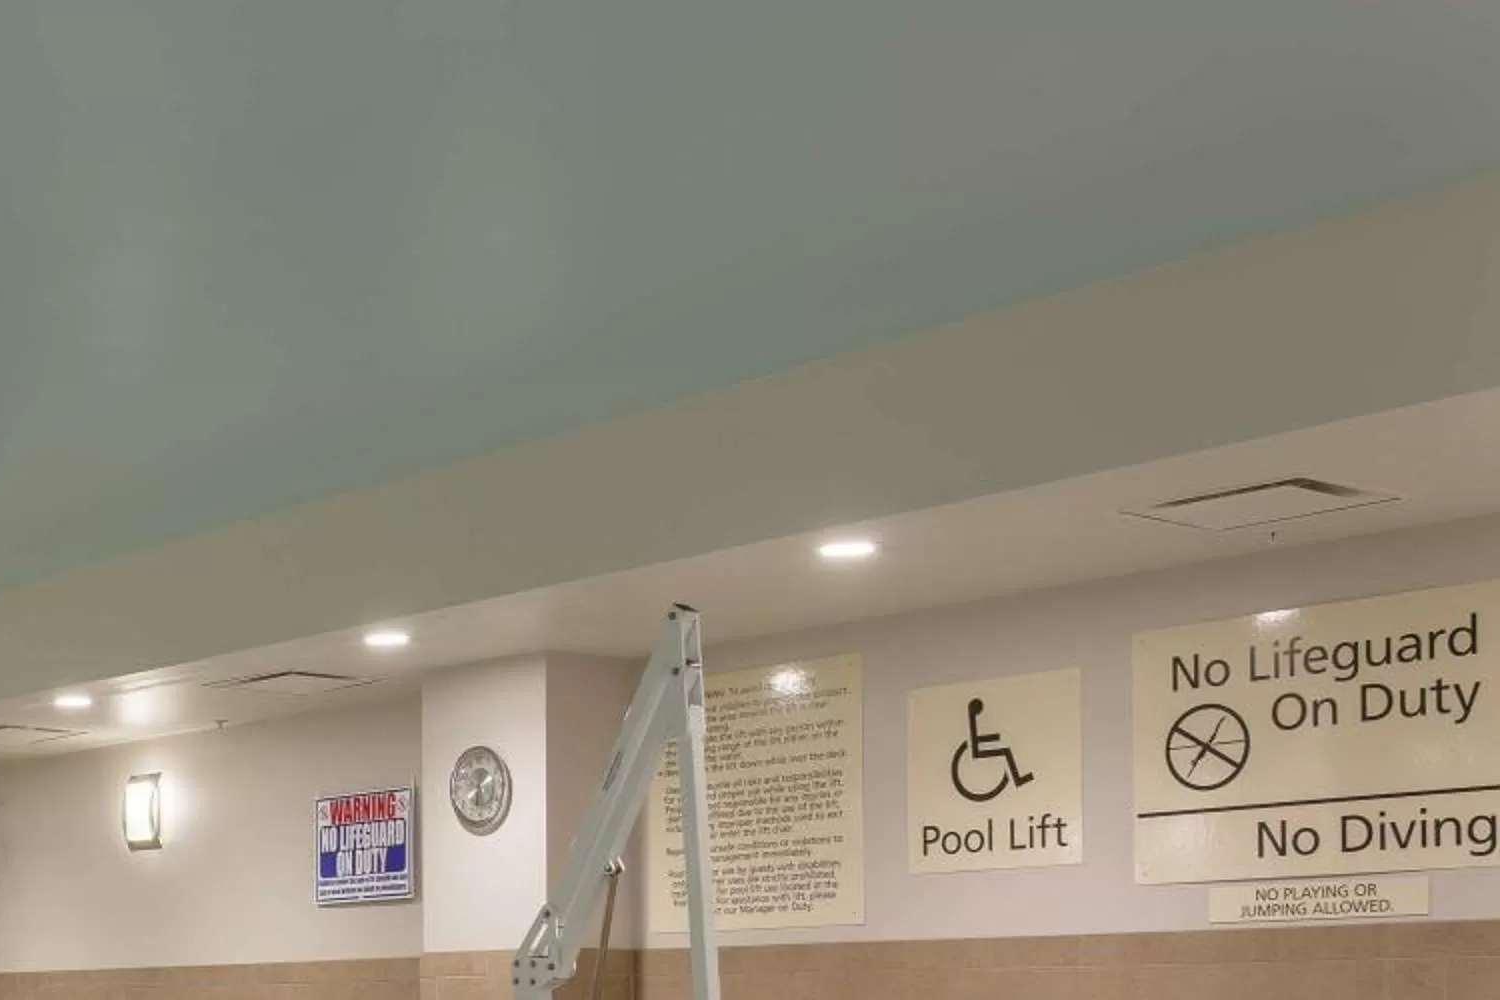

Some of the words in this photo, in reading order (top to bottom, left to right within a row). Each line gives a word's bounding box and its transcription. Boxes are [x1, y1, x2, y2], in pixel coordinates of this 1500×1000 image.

[1172, 653, 1231, 692] No
[1250, 612, 1479, 682] Lifeguard
[1272, 693, 1338, 730] On
[1360, 677, 1481, 724] Duty
[329, 793, 396, 825] WARNING
[321, 826, 338, 852] NO
[340, 819, 405, 851] LIFEGUARD
[923, 818, 993, 857] Pool
[1009, 813, 1068, 850] Lift
[1257, 819, 1320, 858] No
[1340, 808, 1497, 857] Diving
[336, 848, 353, 877] ON
[355, 846, 388, 875] DUTY
[1241, 902, 1307, 918] JUMPING
[1313, 899, 1394, 915] ALLOWED.
[1255, 887, 1279, 902] NO
[1284, 884, 1350, 900] PLAYING
[1354, 883, 1378, 897] OR
